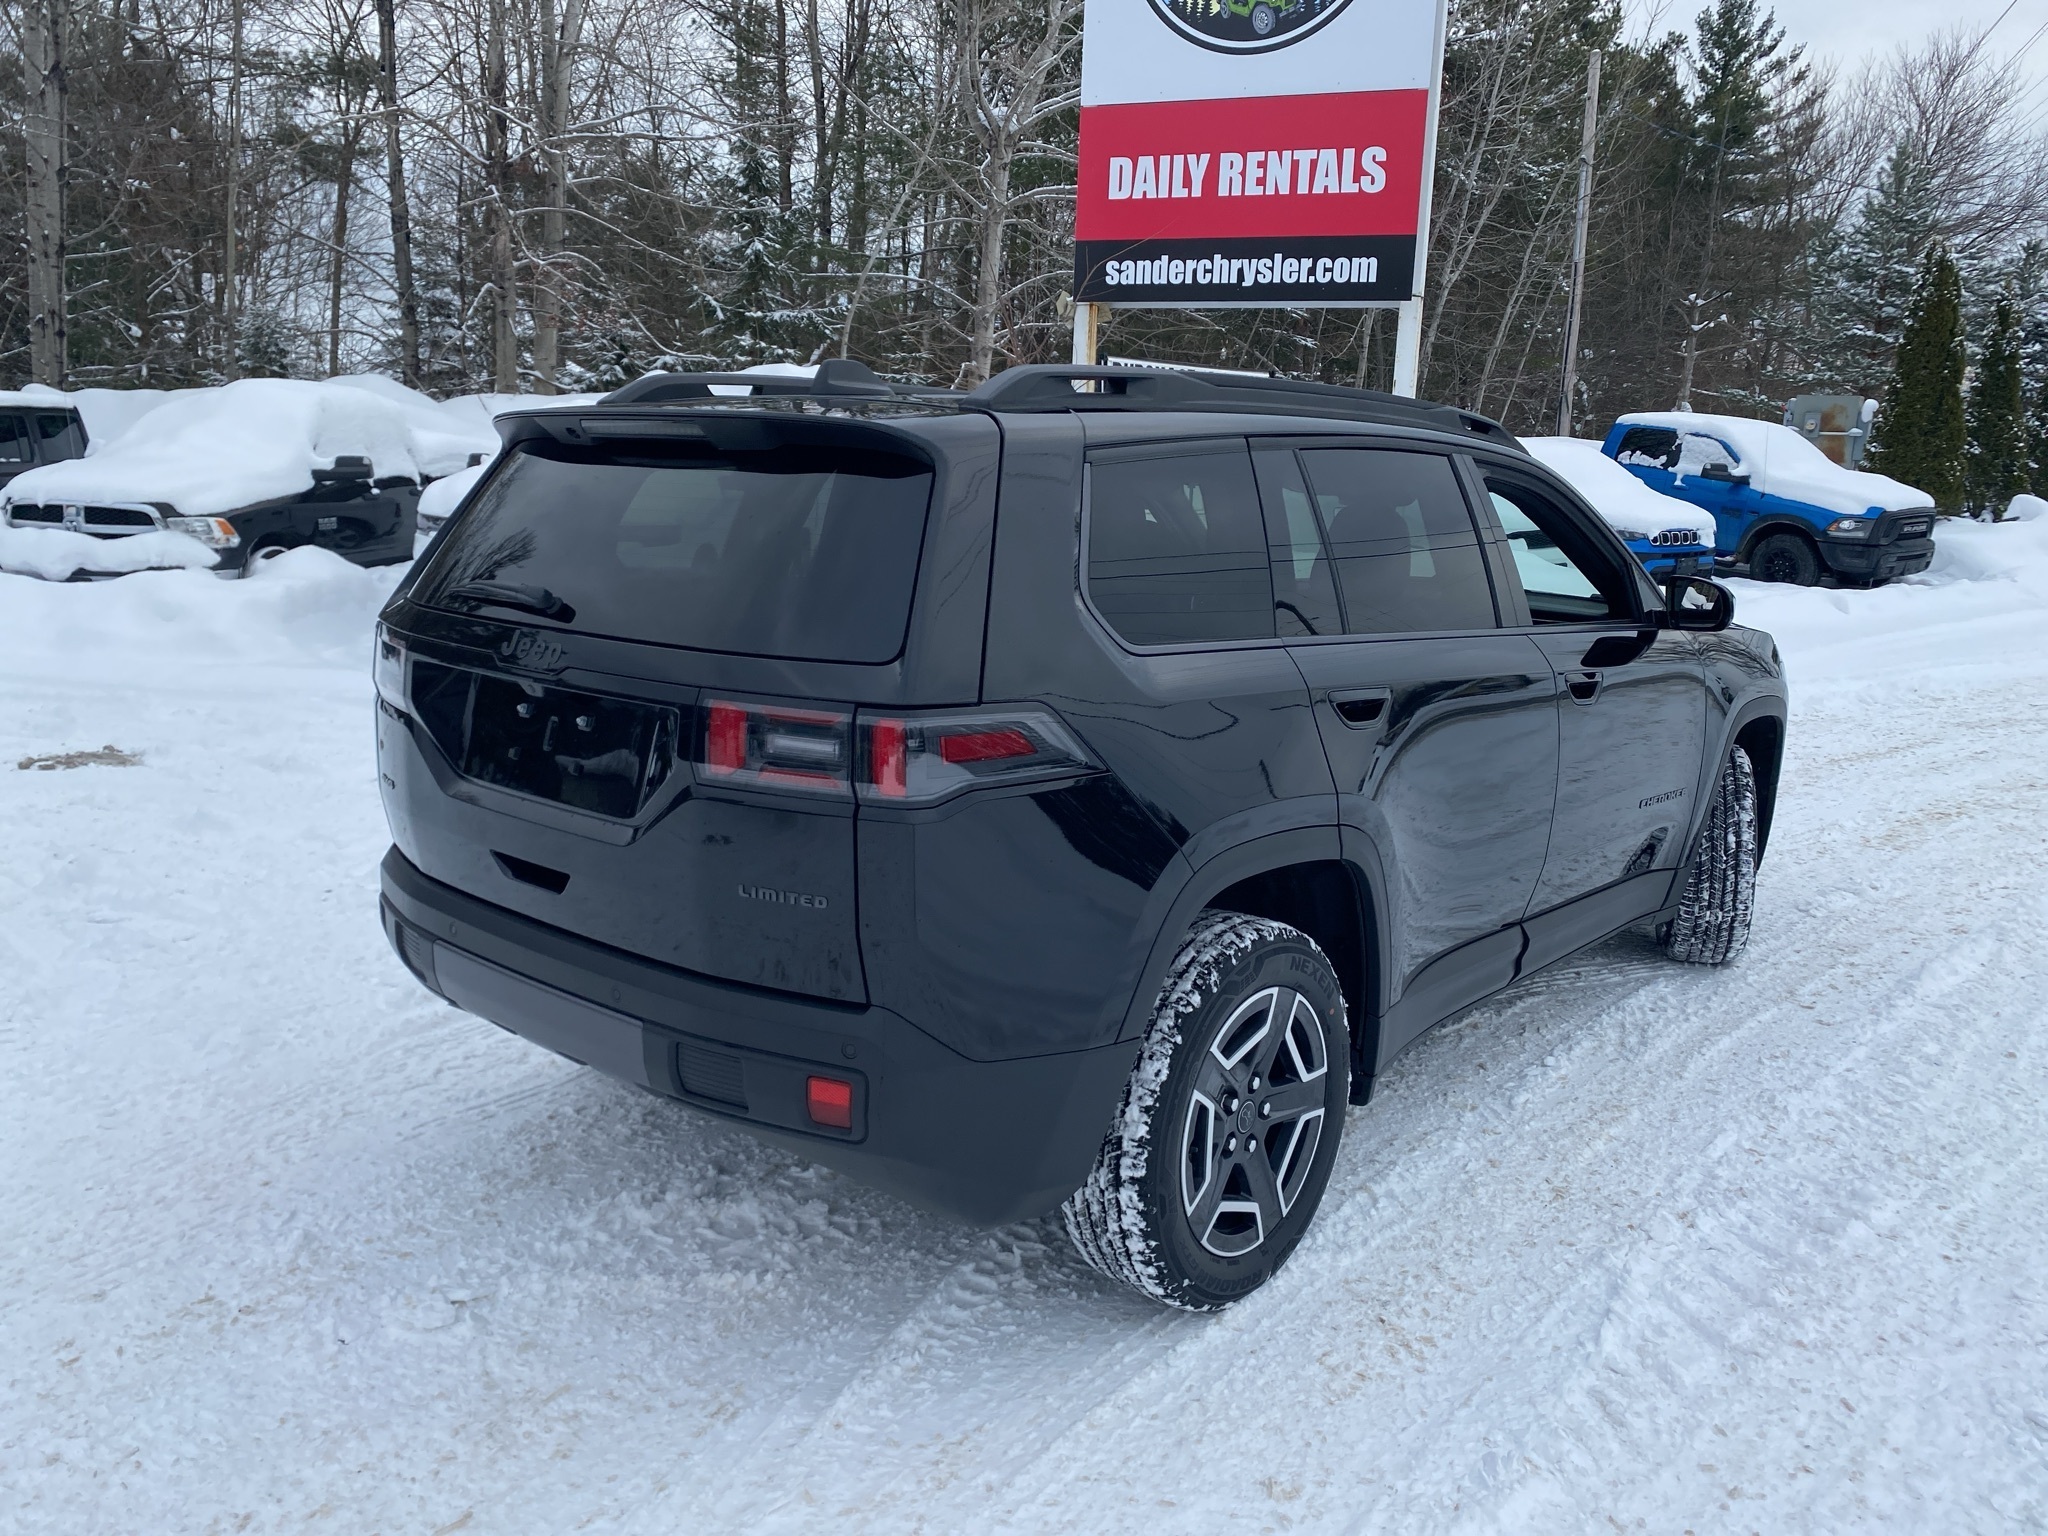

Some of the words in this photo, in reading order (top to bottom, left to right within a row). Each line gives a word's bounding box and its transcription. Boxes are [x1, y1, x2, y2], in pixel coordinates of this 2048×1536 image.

[1108, 153, 1210, 200] DAILY
[1217, 146, 1388, 197] RENTALS
[1105, 252, 1379, 287] sanderchrysler.com
[501, 629, 562, 667] Jeep
[1638, 787, 1687, 809] CHEROKEE
[738, 884, 829, 909] LIMITED
[1290, 956, 1334, 1000] NEXEN
